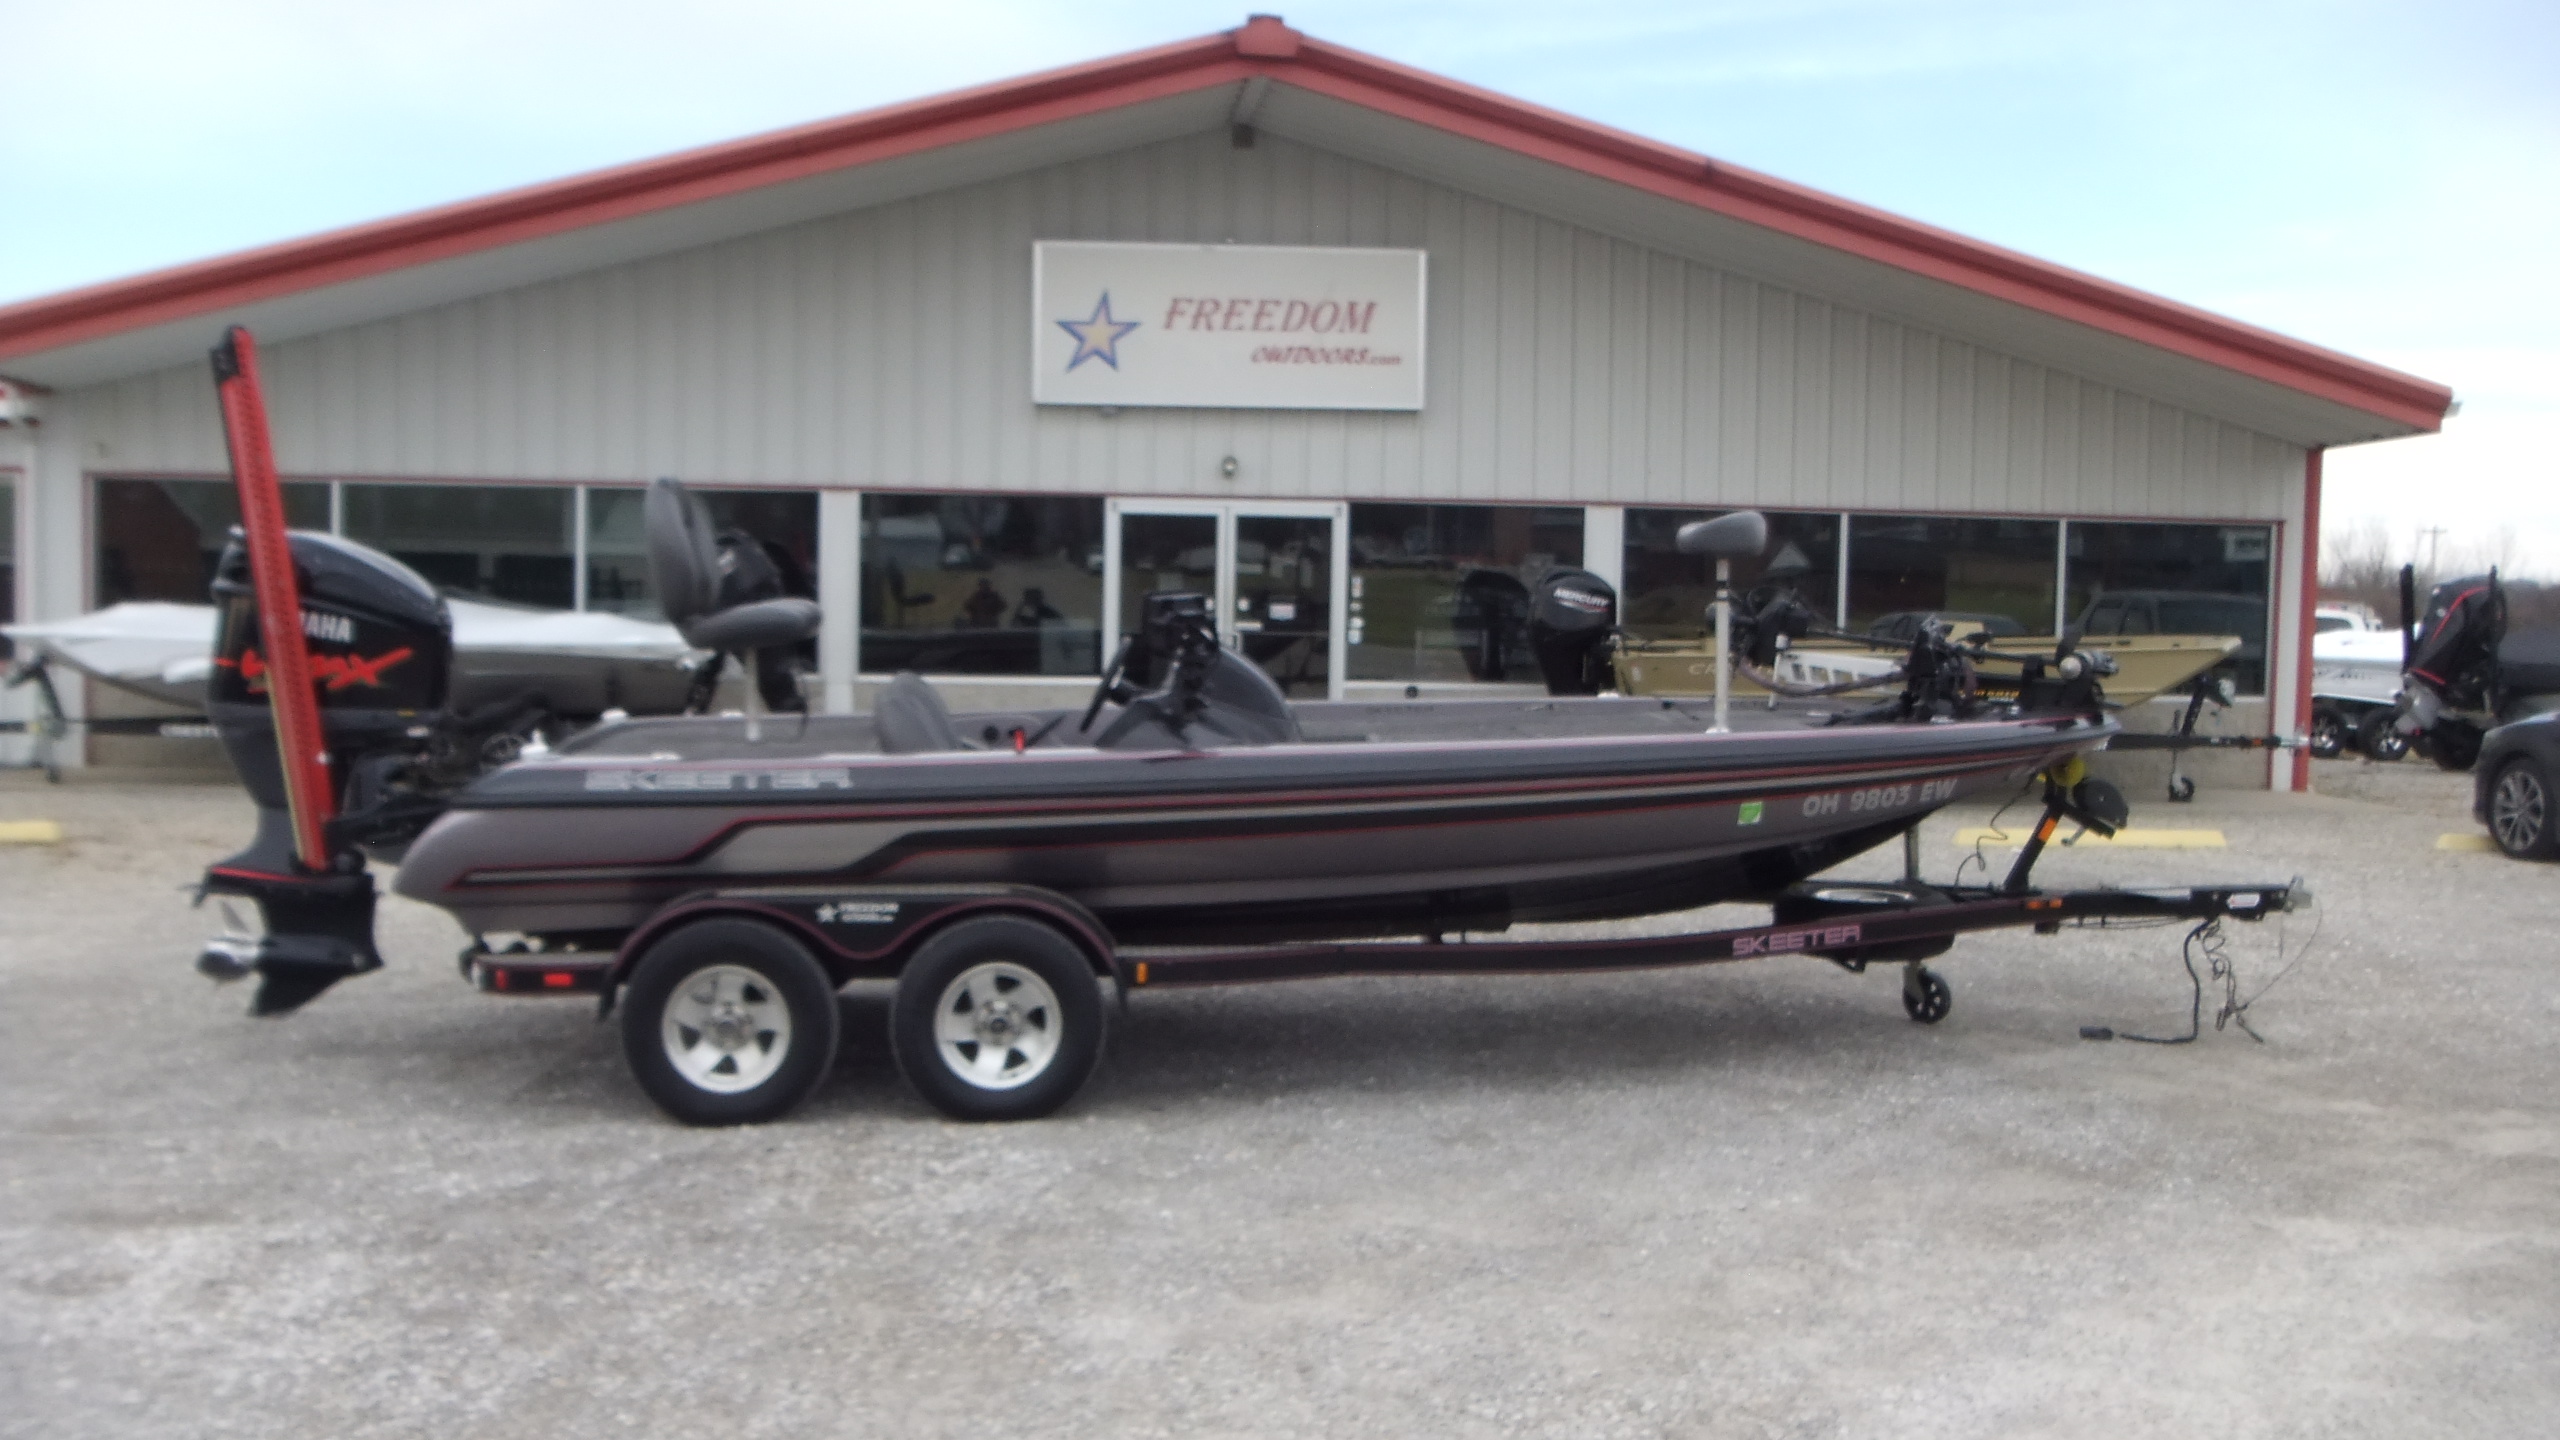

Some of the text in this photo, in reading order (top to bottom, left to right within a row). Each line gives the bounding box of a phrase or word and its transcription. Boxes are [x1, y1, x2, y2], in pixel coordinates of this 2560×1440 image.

[1163, 297, 1378, 334] FREEDOM
[1803, 779, 1957, 817] OH 9803 EW
[1732, 925, 1863, 956] SKEETER
